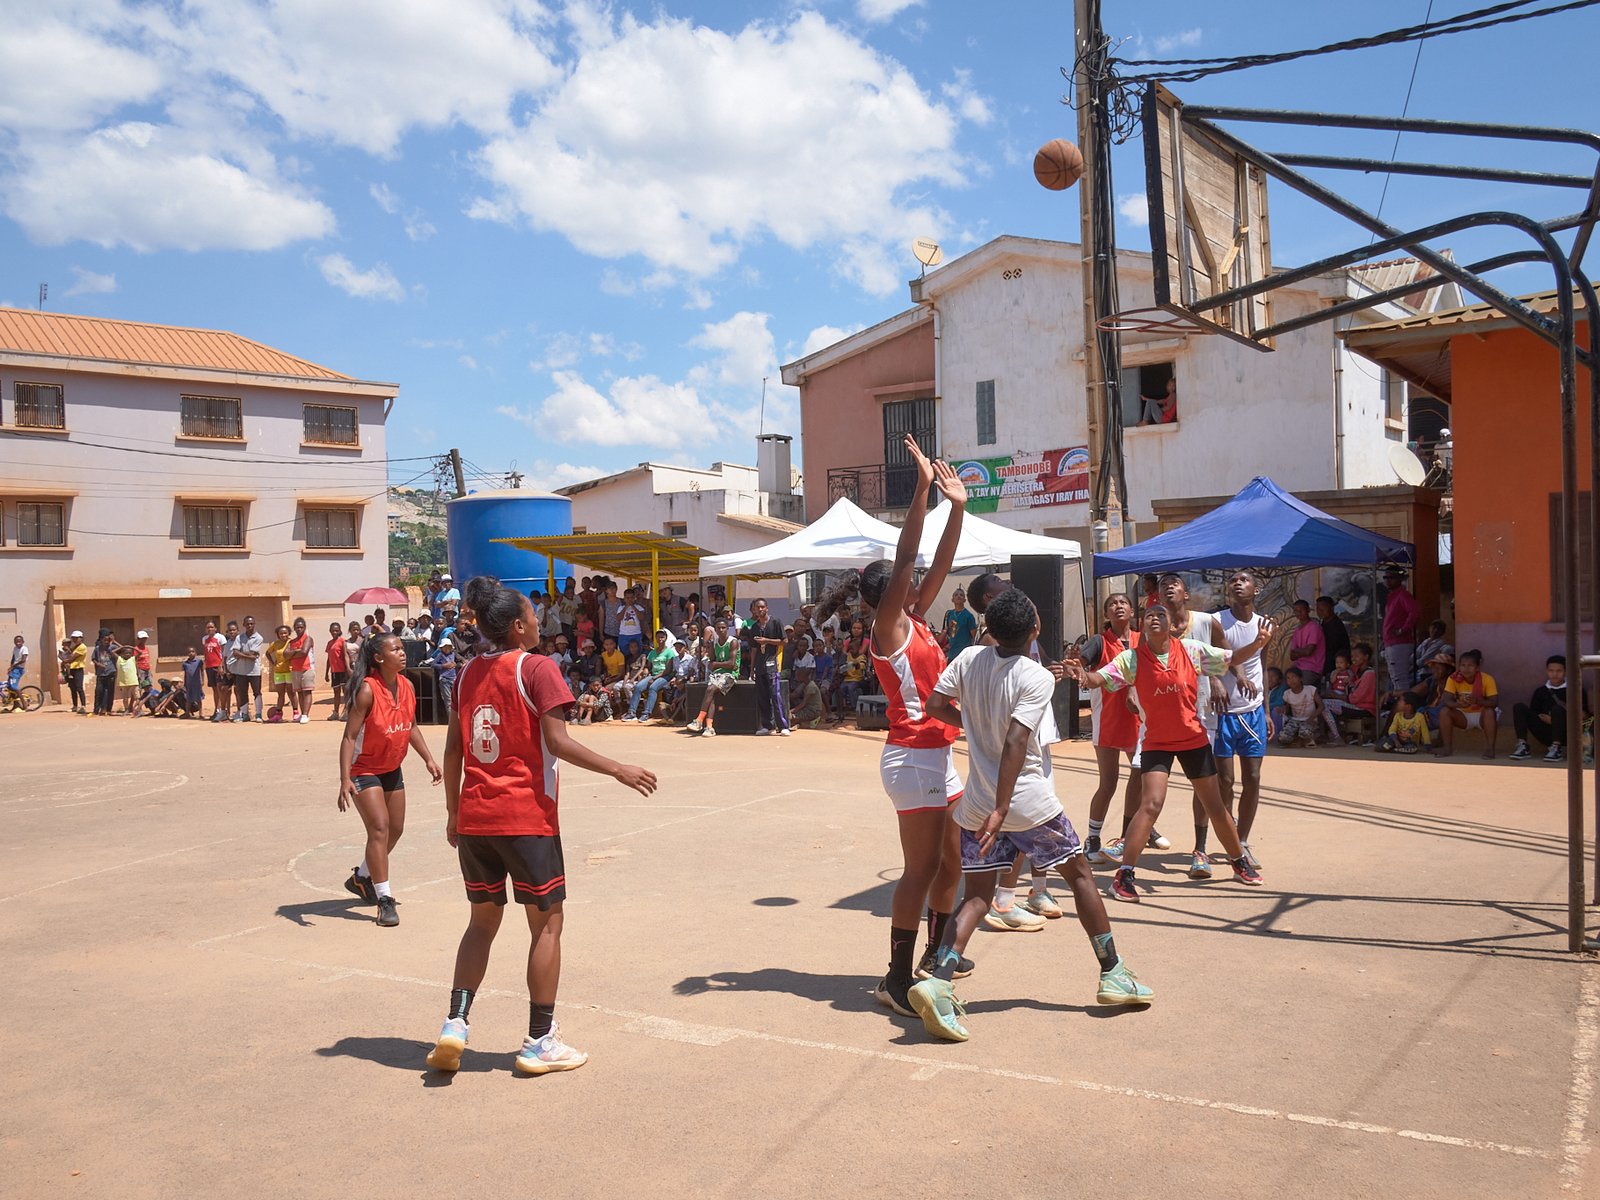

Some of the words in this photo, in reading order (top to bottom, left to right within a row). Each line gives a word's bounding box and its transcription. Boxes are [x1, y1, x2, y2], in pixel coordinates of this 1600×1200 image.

[996, 461, 1051, 478] TAMBOHOBE
[990, 485, 1001, 496] NY
[1013, 494, 1055, 507] MALAGASY
[1055, 490, 1074, 503] IRAY
[470, 704, 501, 764] 6
